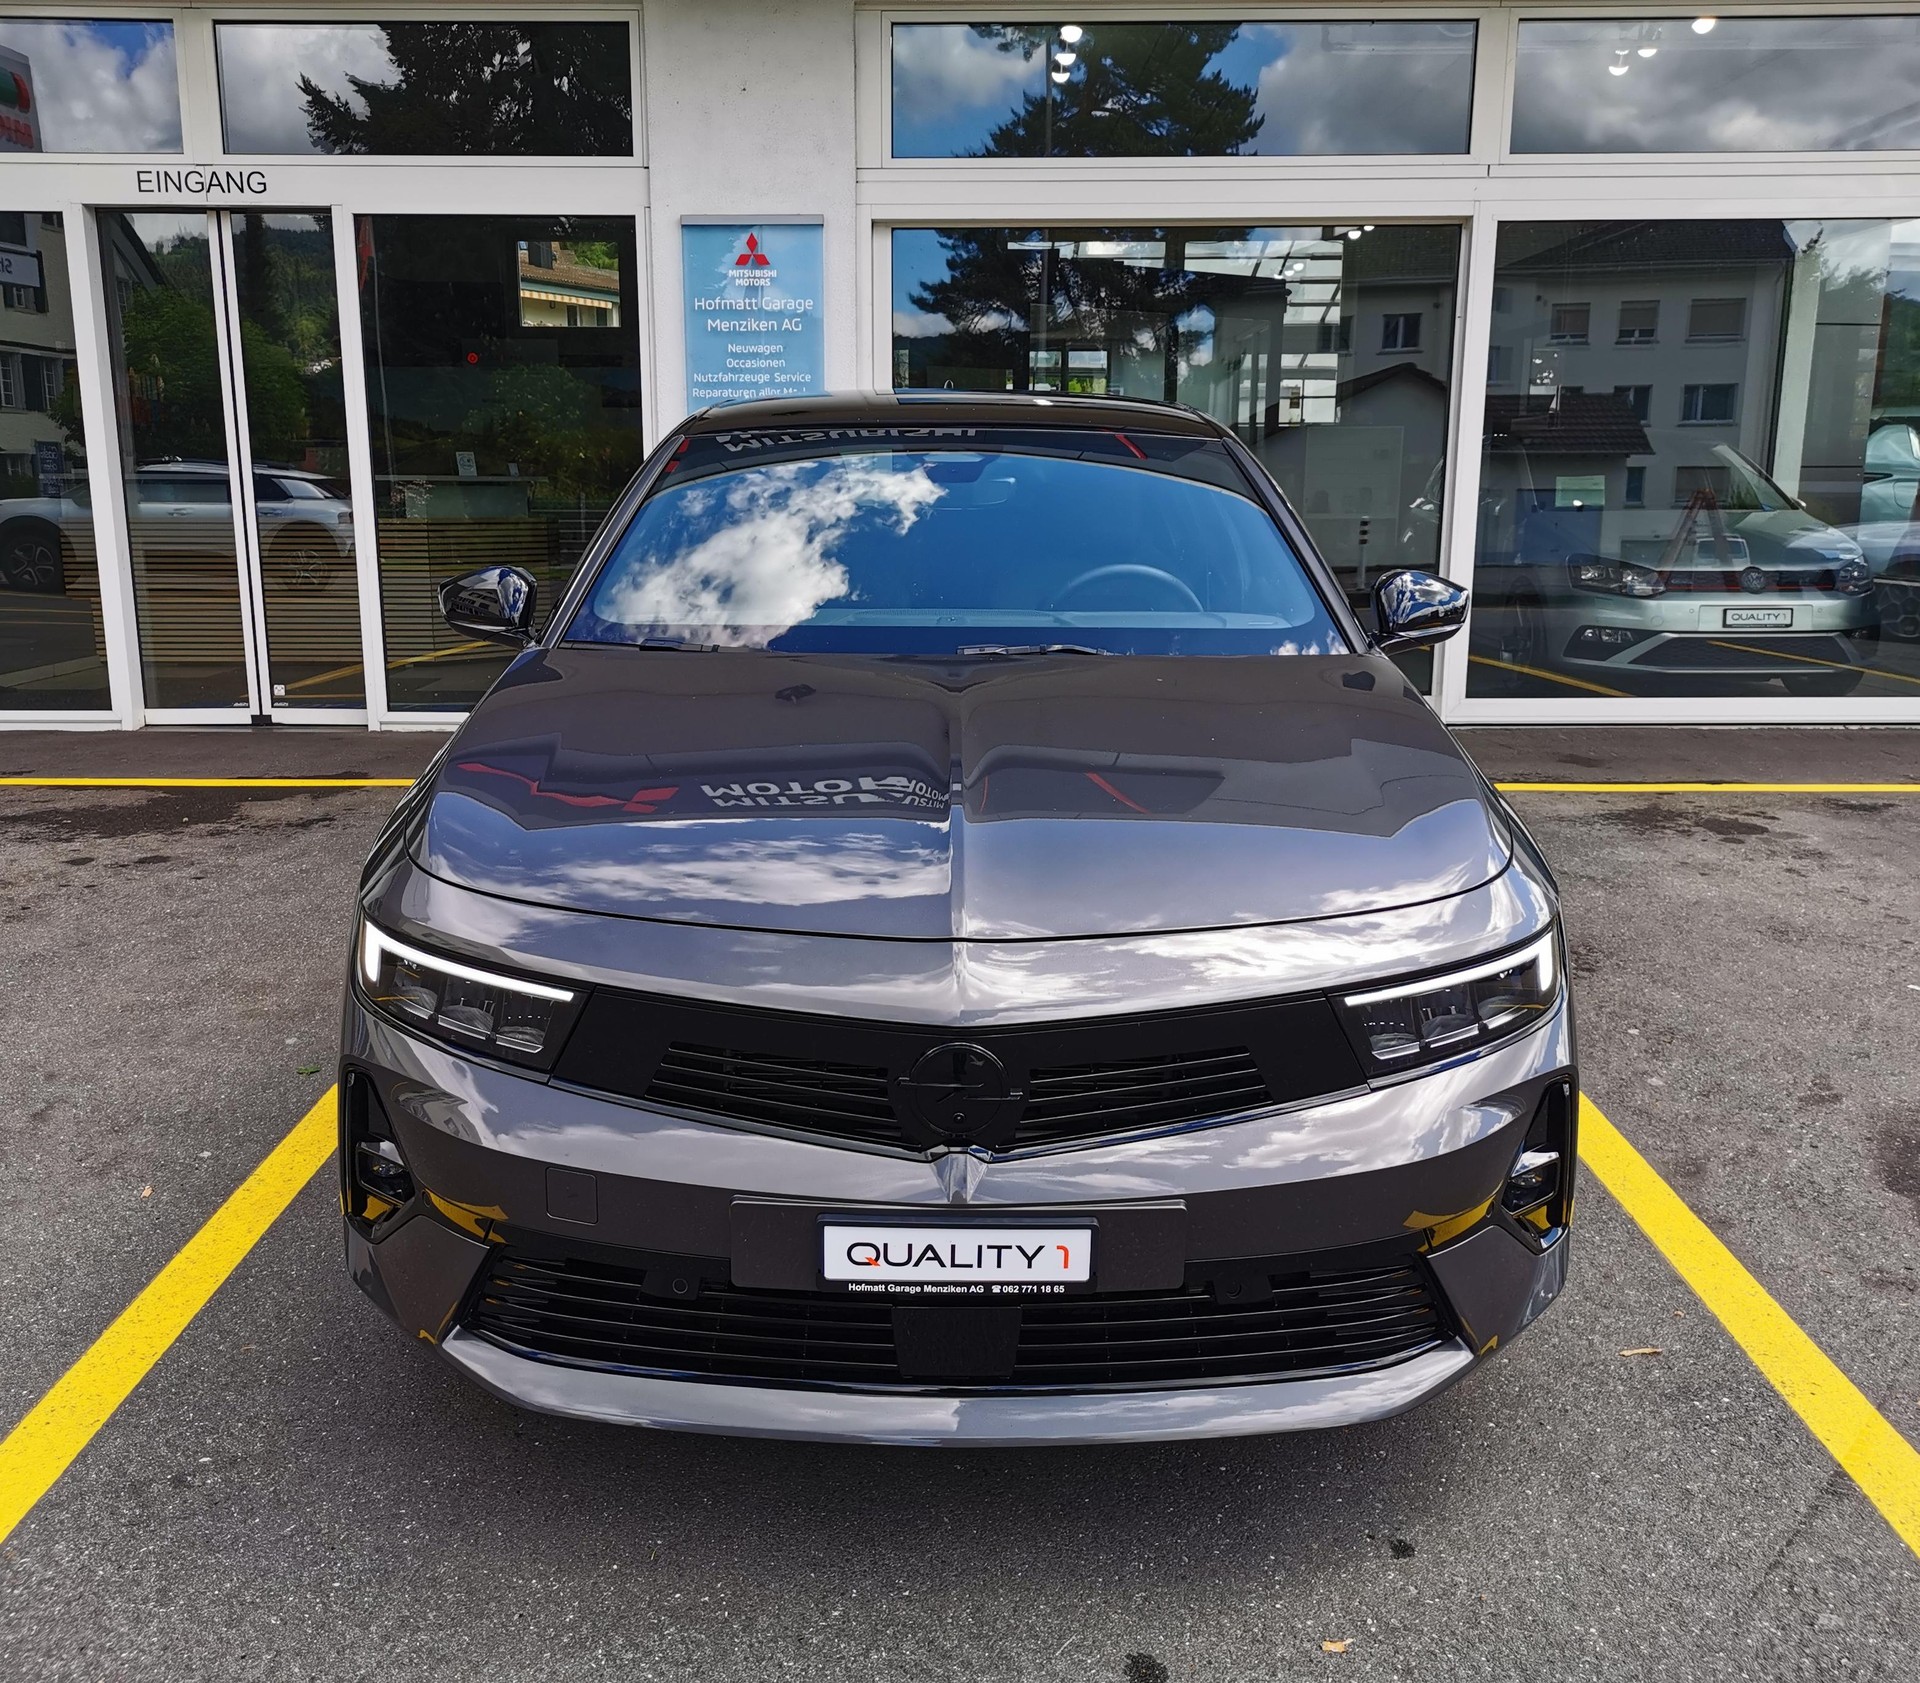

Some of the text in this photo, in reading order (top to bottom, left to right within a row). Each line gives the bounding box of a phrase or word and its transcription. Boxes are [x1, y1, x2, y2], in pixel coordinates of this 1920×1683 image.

[136, 170, 268, 195] EINGANG
[728, 269, 777, 278] MITSUBISHI
[735, 278, 771, 287] MOTORS
[694, 296, 814, 313] Hofmatt Garage
[707, 318, 802, 332] Menziken AG
[728, 343, 783, 355] Neuwagen
[726, 358, 786, 368] Occasionen
[693, 372, 812, 385] Nutzfahrzeuge Service
[692, 387, 757, 399] Reparaturen
[1731, 613, 1781, 621] QUALITY
[846, 1241, 1070, 1270] QUALITY 1
[848, 1283, 1065, 1294] Hofmatt Garage Menziken AG 062 771 18 65
